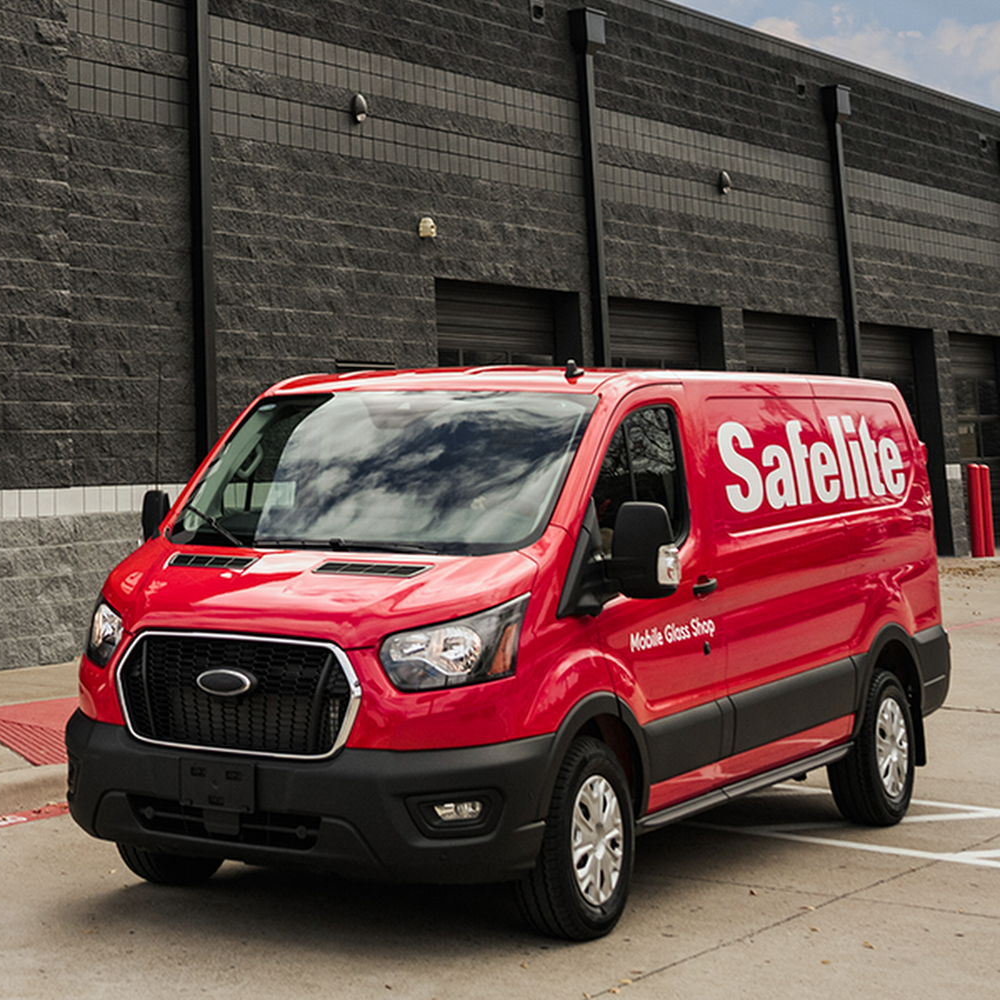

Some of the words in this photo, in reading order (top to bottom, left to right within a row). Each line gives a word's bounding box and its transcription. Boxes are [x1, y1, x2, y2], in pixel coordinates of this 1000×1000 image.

[717, 415, 906, 514] Safelite
[629, 627, 663, 653] Mobile
[664, 622, 691, 644] Glass
[690, 617, 716, 638] Shop
